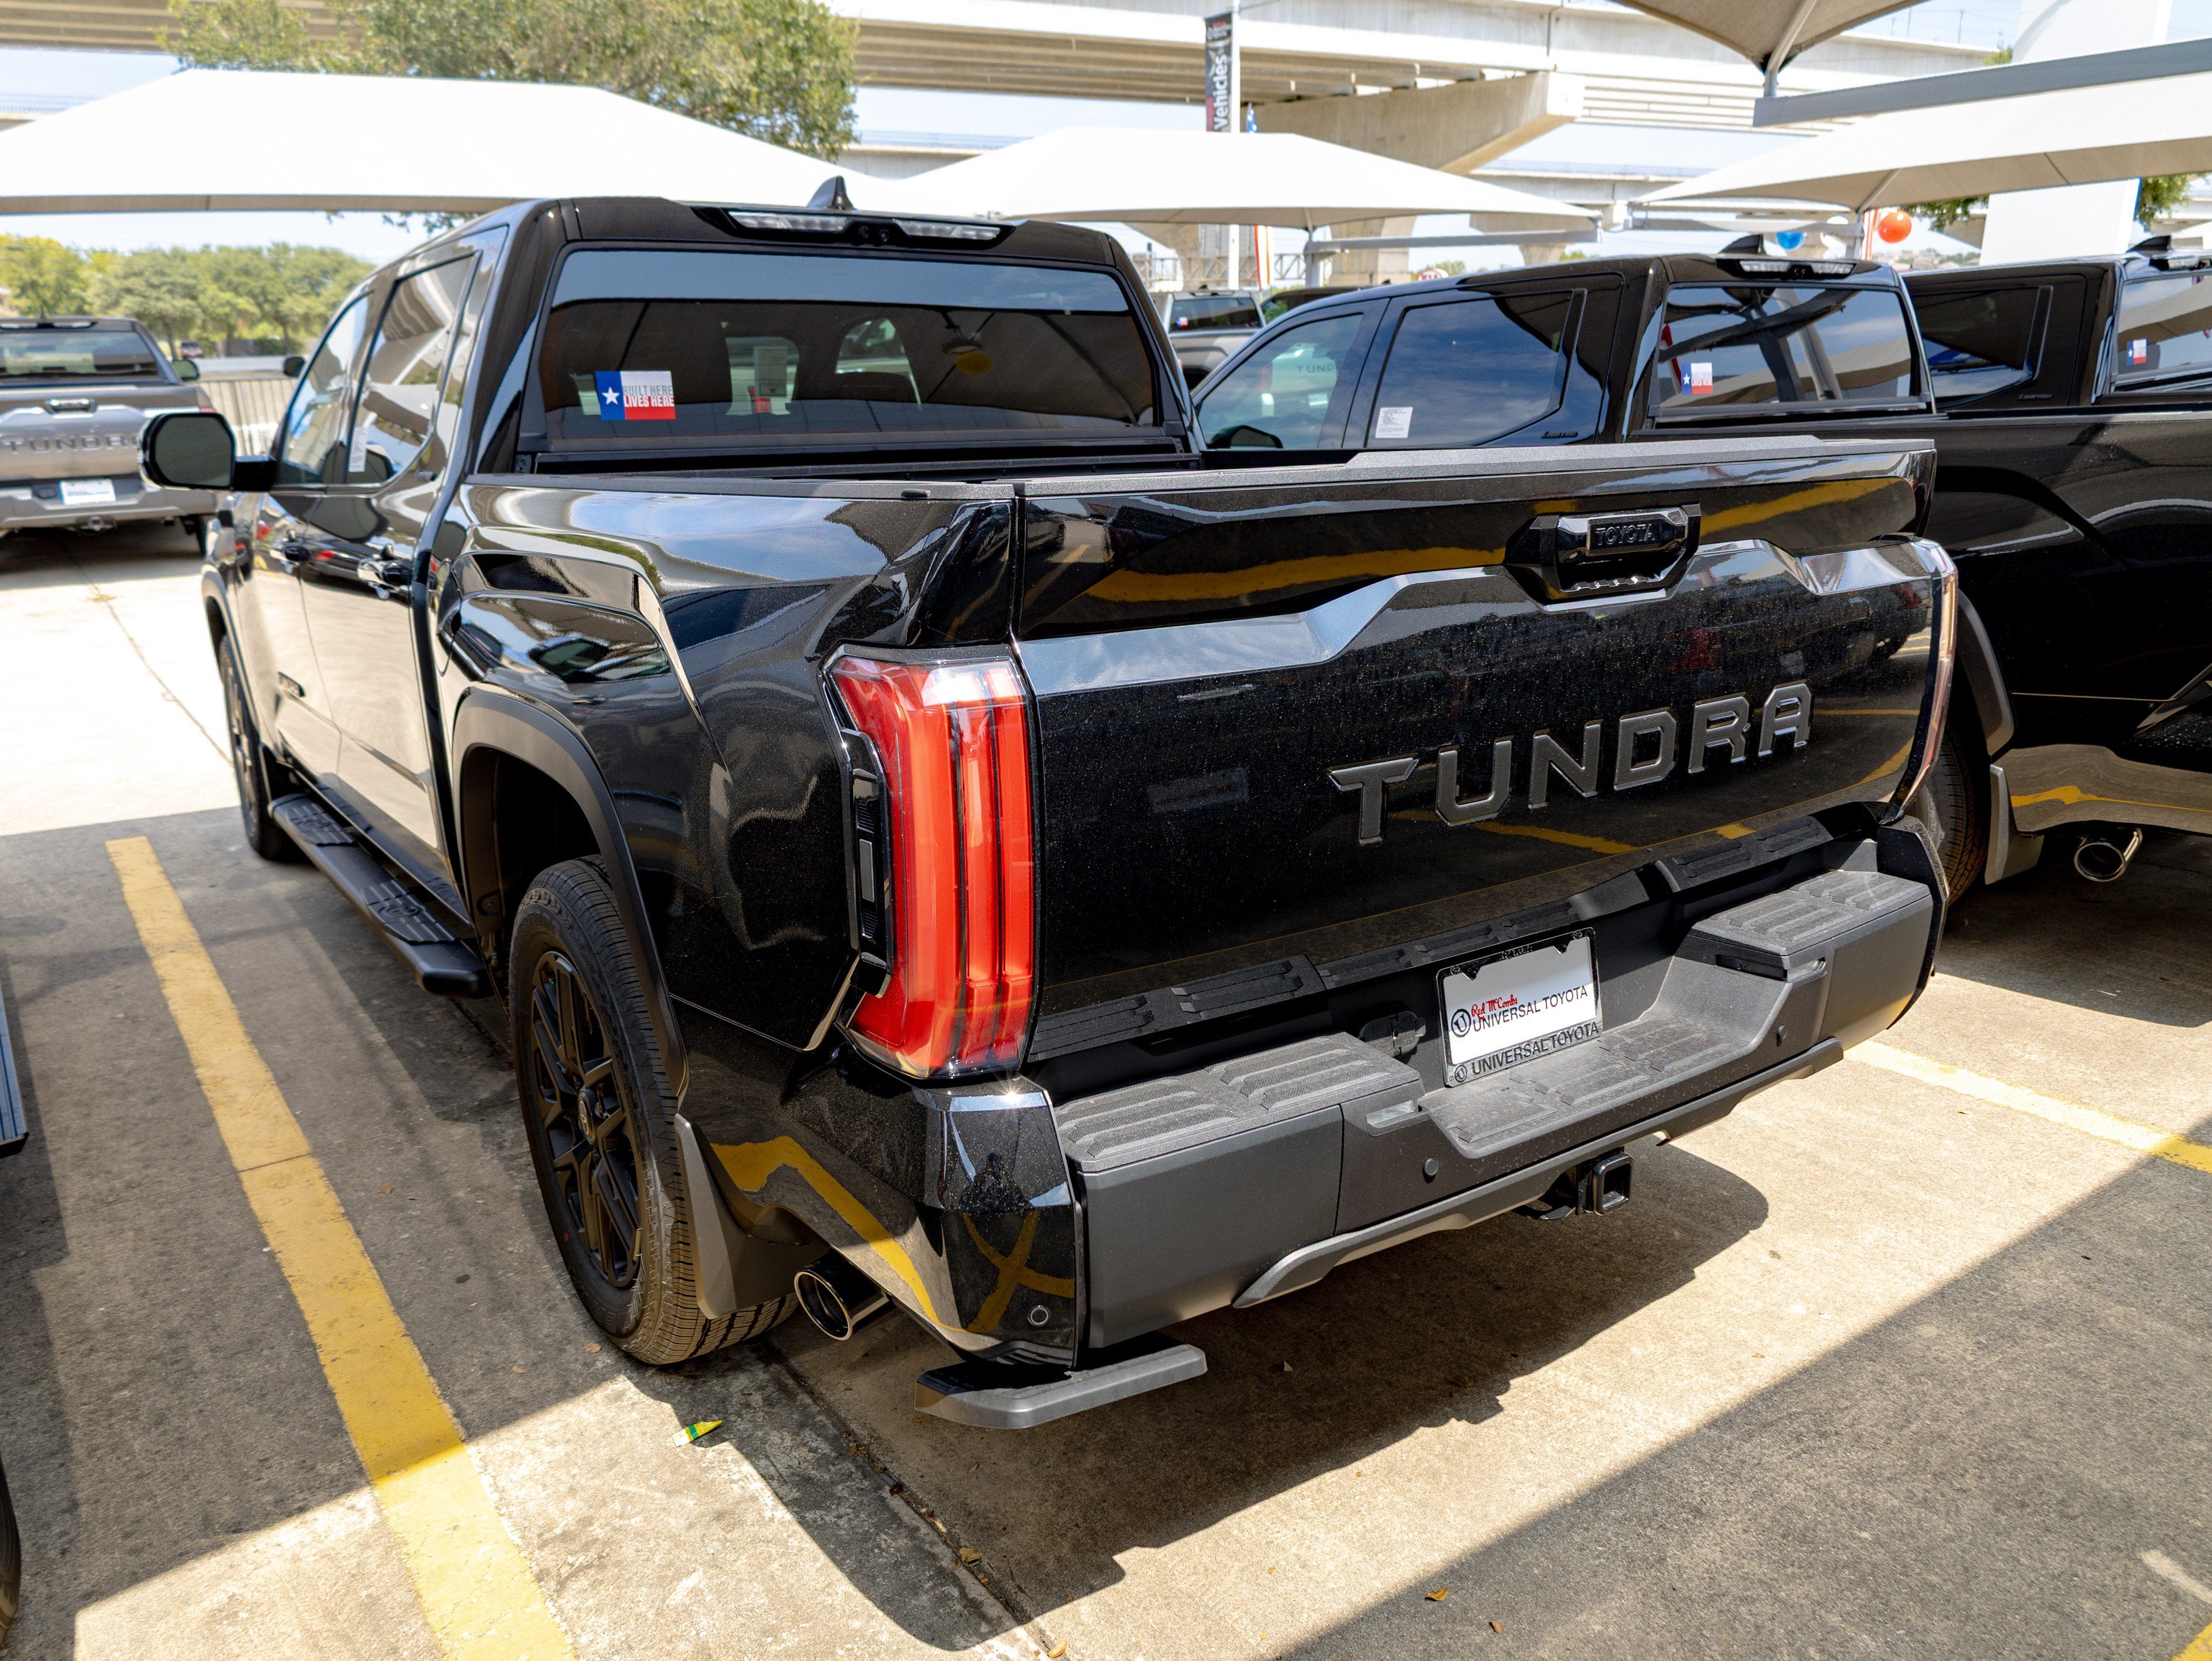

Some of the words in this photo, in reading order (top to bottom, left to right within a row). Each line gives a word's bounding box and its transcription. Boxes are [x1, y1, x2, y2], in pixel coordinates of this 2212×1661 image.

[1213, 54, 1228, 131] Vehicles
[1298, 364, 1335, 374] TUND
[623, 385, 647, 396] BUILT
[649, 385, 673, 396] HERE
[623, 396, 649, 407] LIVES
[651, 396, 675, 407] HERE
[1595, 524, 1656, 546] TOYOTA
[1326, 679, 1812, 845] TUNDRA
[1471, 1002, 1486, 1019] Red
[1473, 1000, 1541, 1032] UNIVERSAL
[1542, 985, 1588, 1009] TOYOTA
[1471, 1037, 1549, 1075] UNIVERSAL
[1548, 1021, 1599, 1049] TOYOTA
